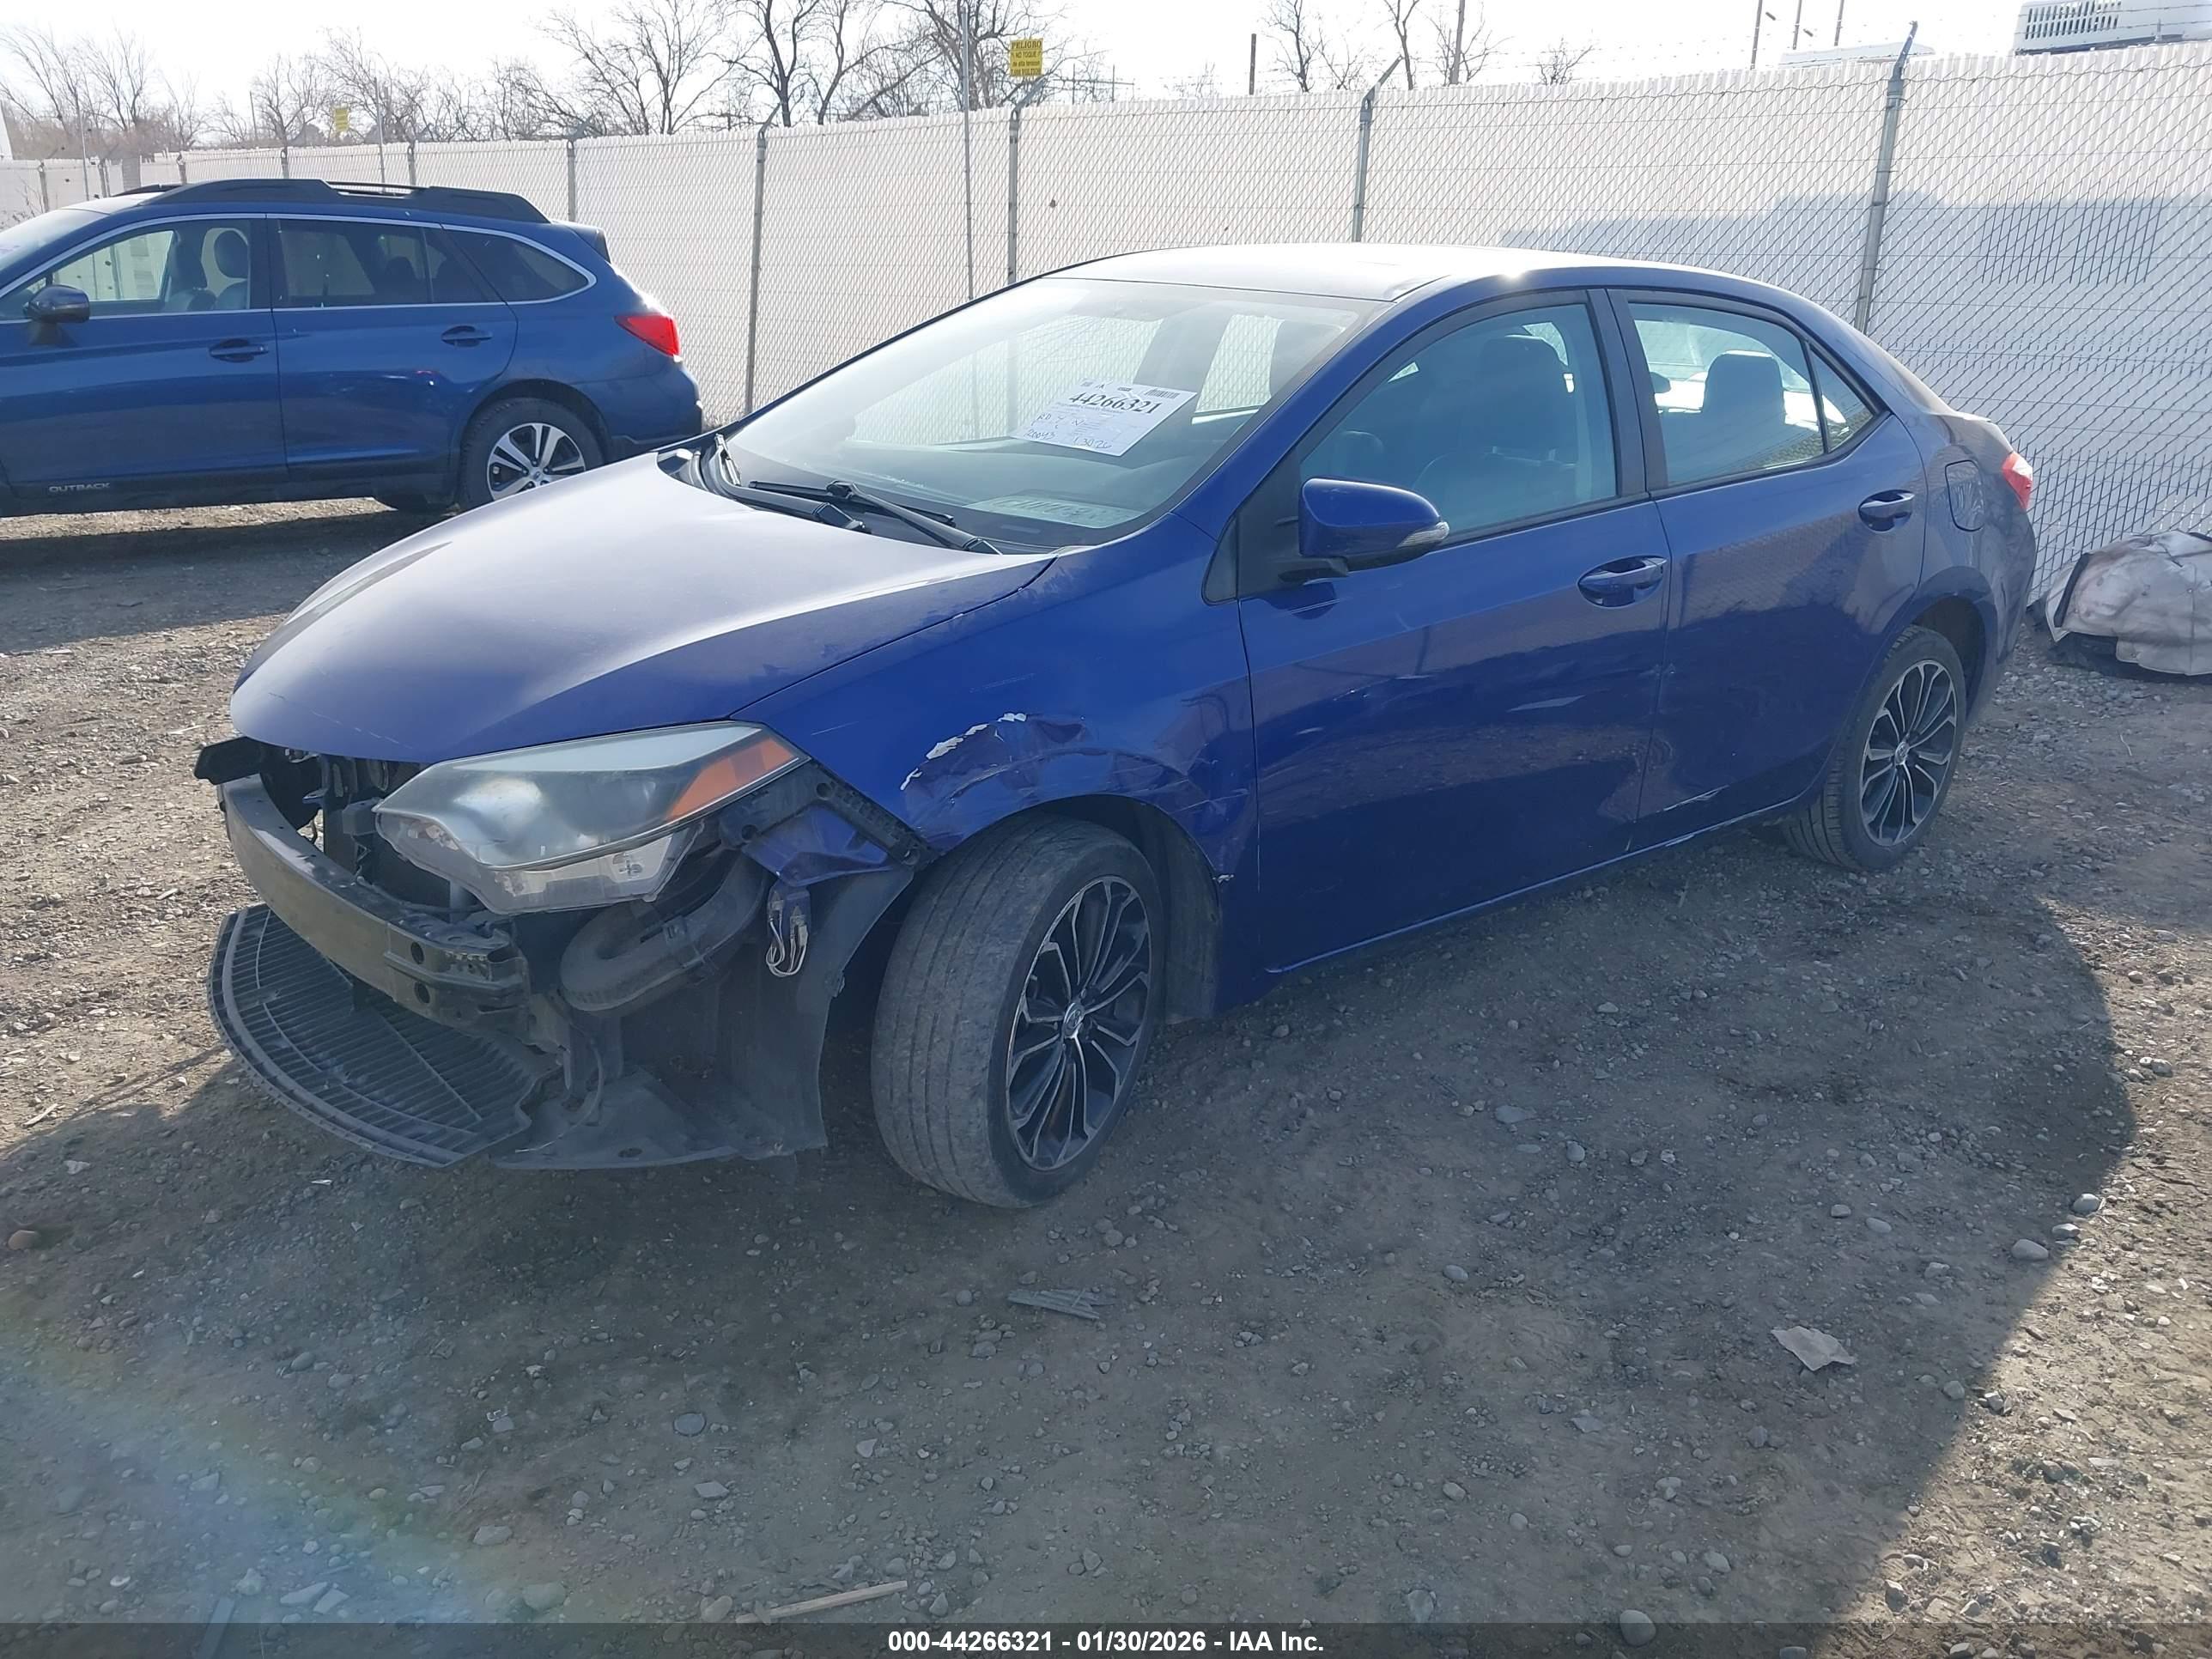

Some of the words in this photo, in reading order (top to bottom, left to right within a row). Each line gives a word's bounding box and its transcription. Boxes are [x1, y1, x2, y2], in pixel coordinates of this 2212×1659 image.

[1011, 40, 1042, 49] PELIGRO
[1068, 392, 1163, 414] 44266321
[48, 482, 111, 493] OUTBACK
